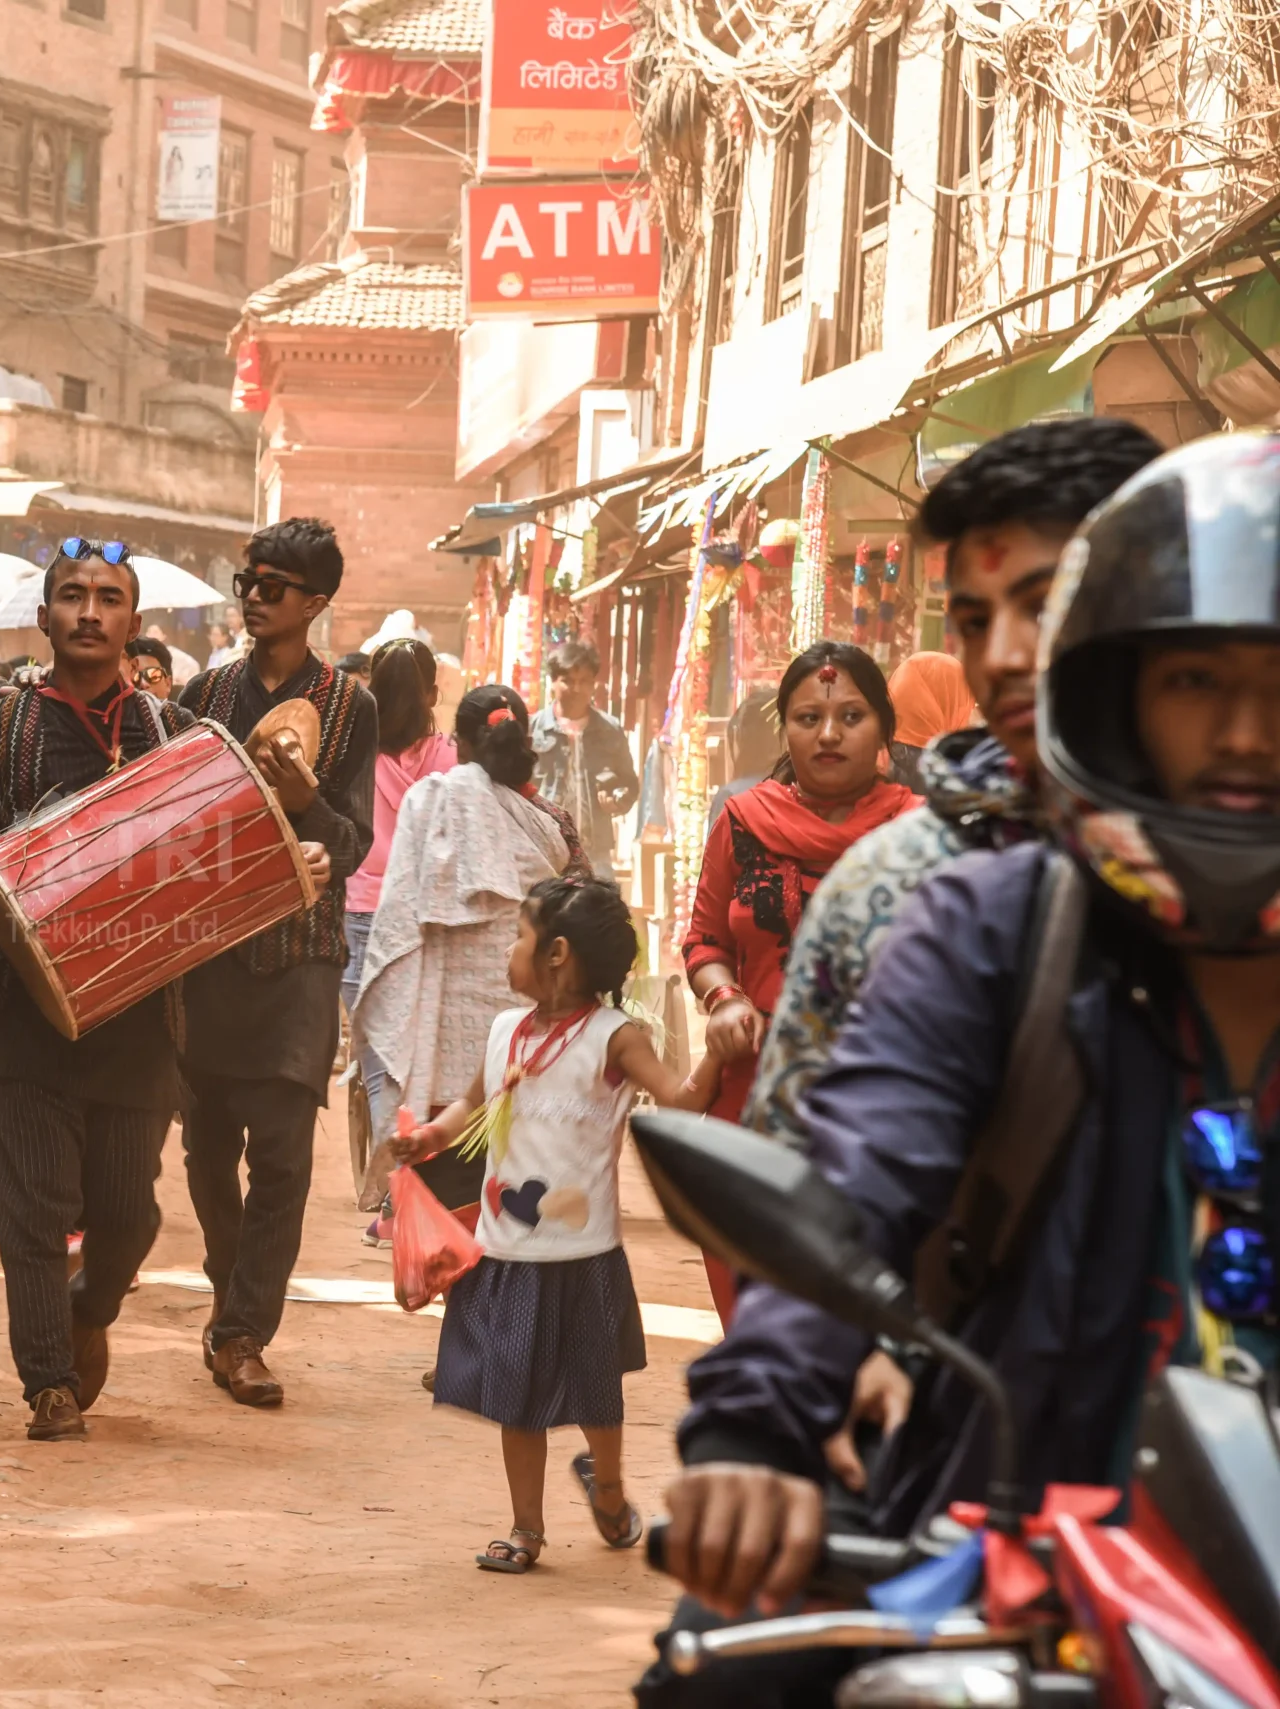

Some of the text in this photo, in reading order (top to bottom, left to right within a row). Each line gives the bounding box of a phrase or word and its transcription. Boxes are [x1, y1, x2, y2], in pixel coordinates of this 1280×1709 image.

[547, 7, 597, 40] बैंक
[520, 58, 619, 90] लिमिटेड
[480, 200, 651, 260] ATM
